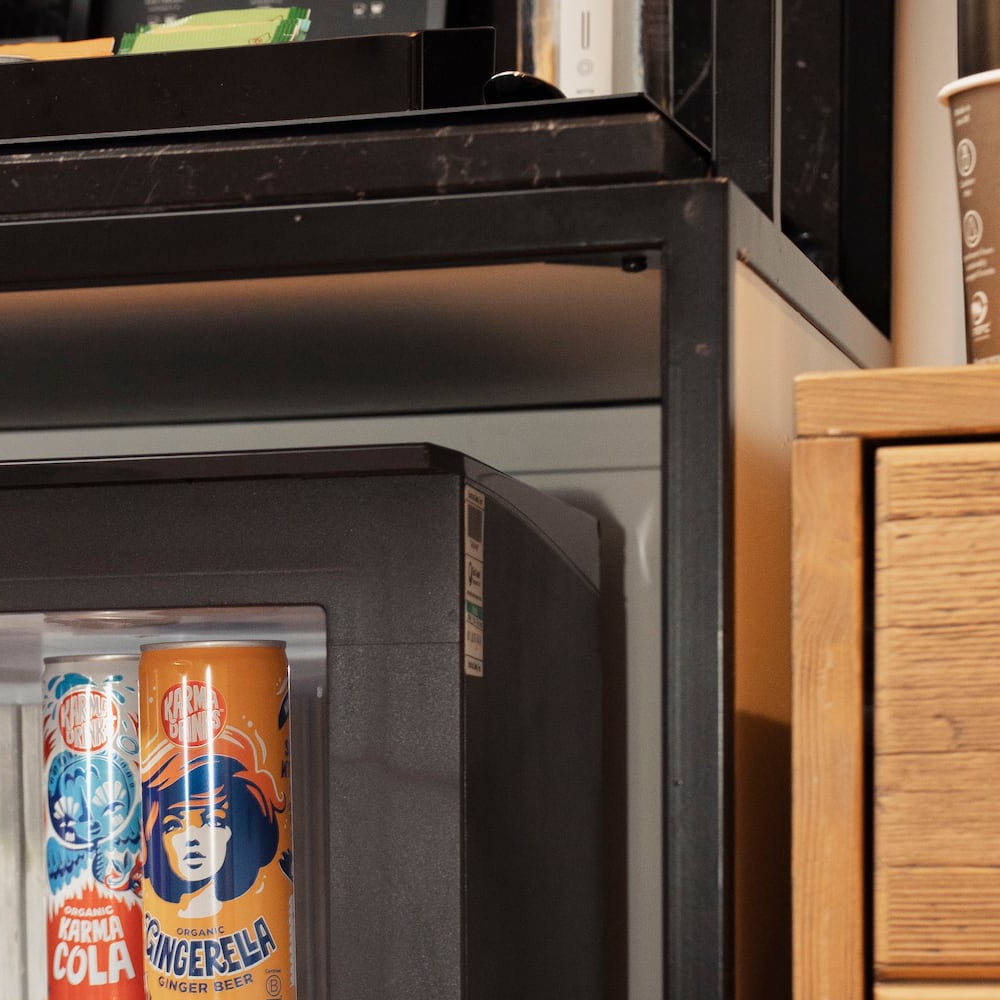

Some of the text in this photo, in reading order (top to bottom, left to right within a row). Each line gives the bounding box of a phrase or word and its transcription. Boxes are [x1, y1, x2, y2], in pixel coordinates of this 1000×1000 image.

[164, 684, 219, 723] KARMA
[63, 905, 114, 917] ORGANIC
[58, 915, 124, 943] KARMA
[176, 926, 225, 937] ORGANIC
[145, 915, 276, 977] GINGERELLA
[53, 940, 136, 986] COLA
[158, 973, 254, 993] GINGER BEER
